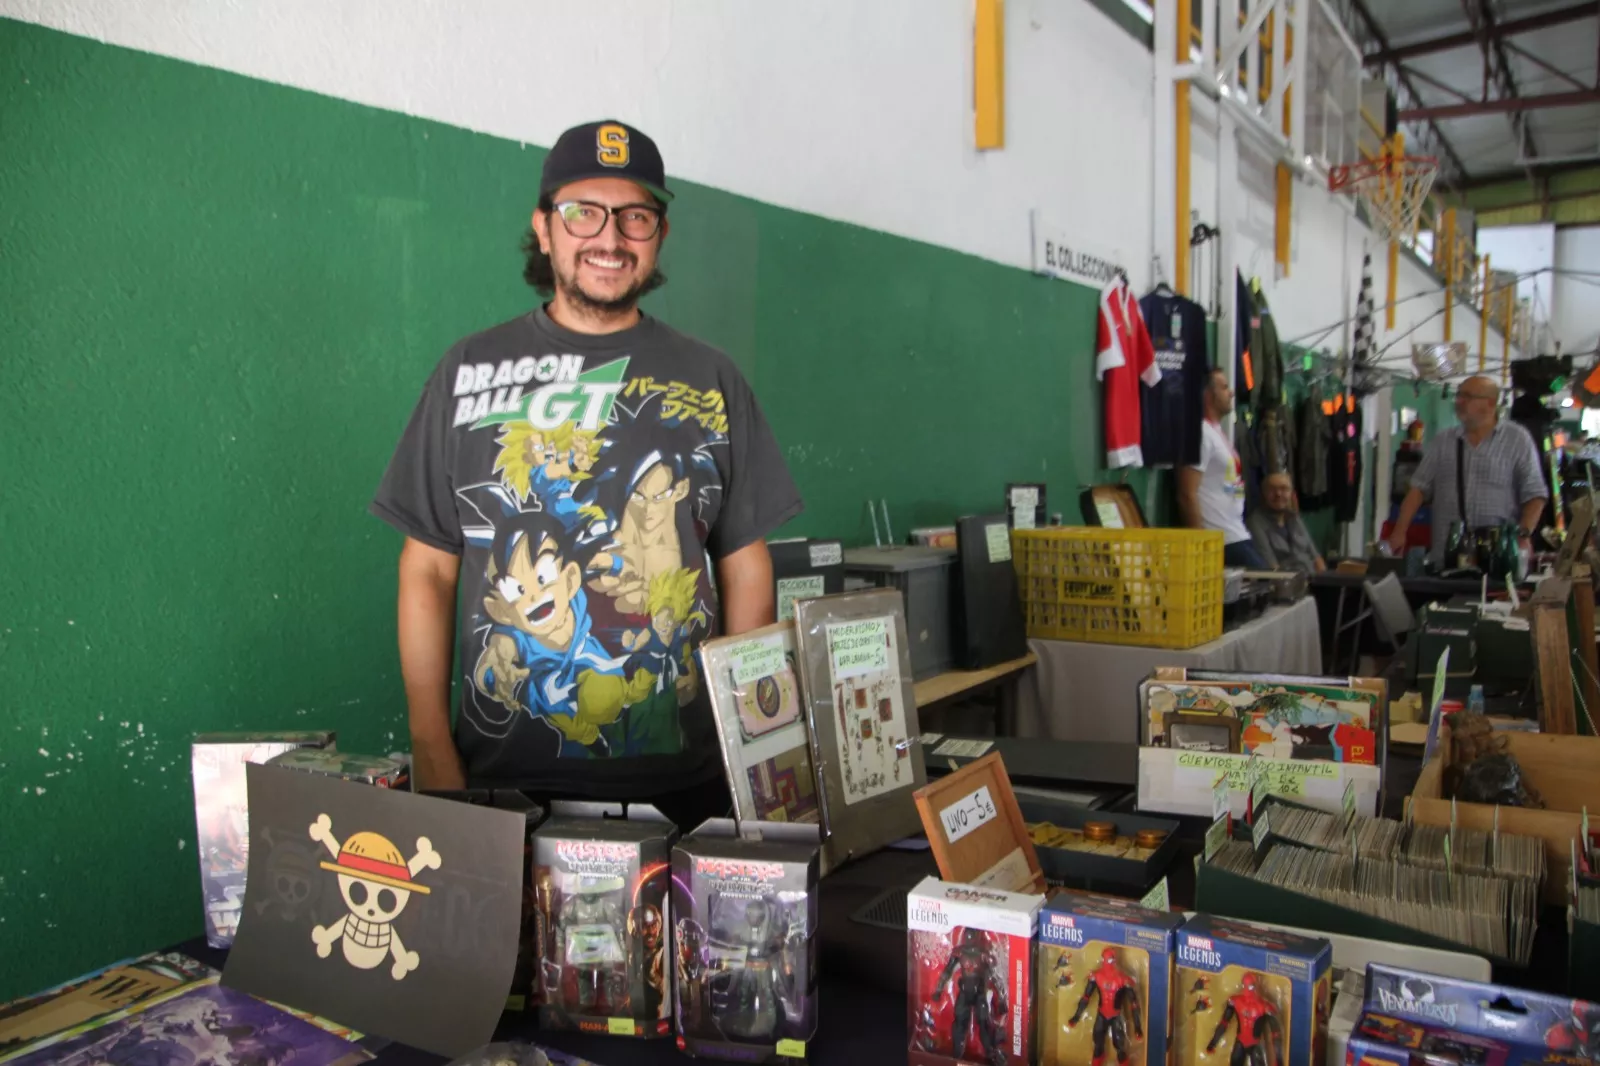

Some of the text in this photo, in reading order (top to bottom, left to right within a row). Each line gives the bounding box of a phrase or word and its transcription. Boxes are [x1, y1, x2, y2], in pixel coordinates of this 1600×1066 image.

[596, 124, 630, 168] S
[452, 354, 585, 397] DRAGON
[452, 385, 524, 428] BALL
[527, 382, 628, 431] GT
[556, 840, 638, 859] MASTERS
[697, 858, 785, 882] MASTERS
[911, 909, 949, 926] LEGENDS
[1051, 913, 1075, 928] MARVEL
[1042, 923, 1083, 944] LEGENDS
[1187, 935, 1213, 950] MARVEL
[1178, 944, 1222, 967] LEGENDS
